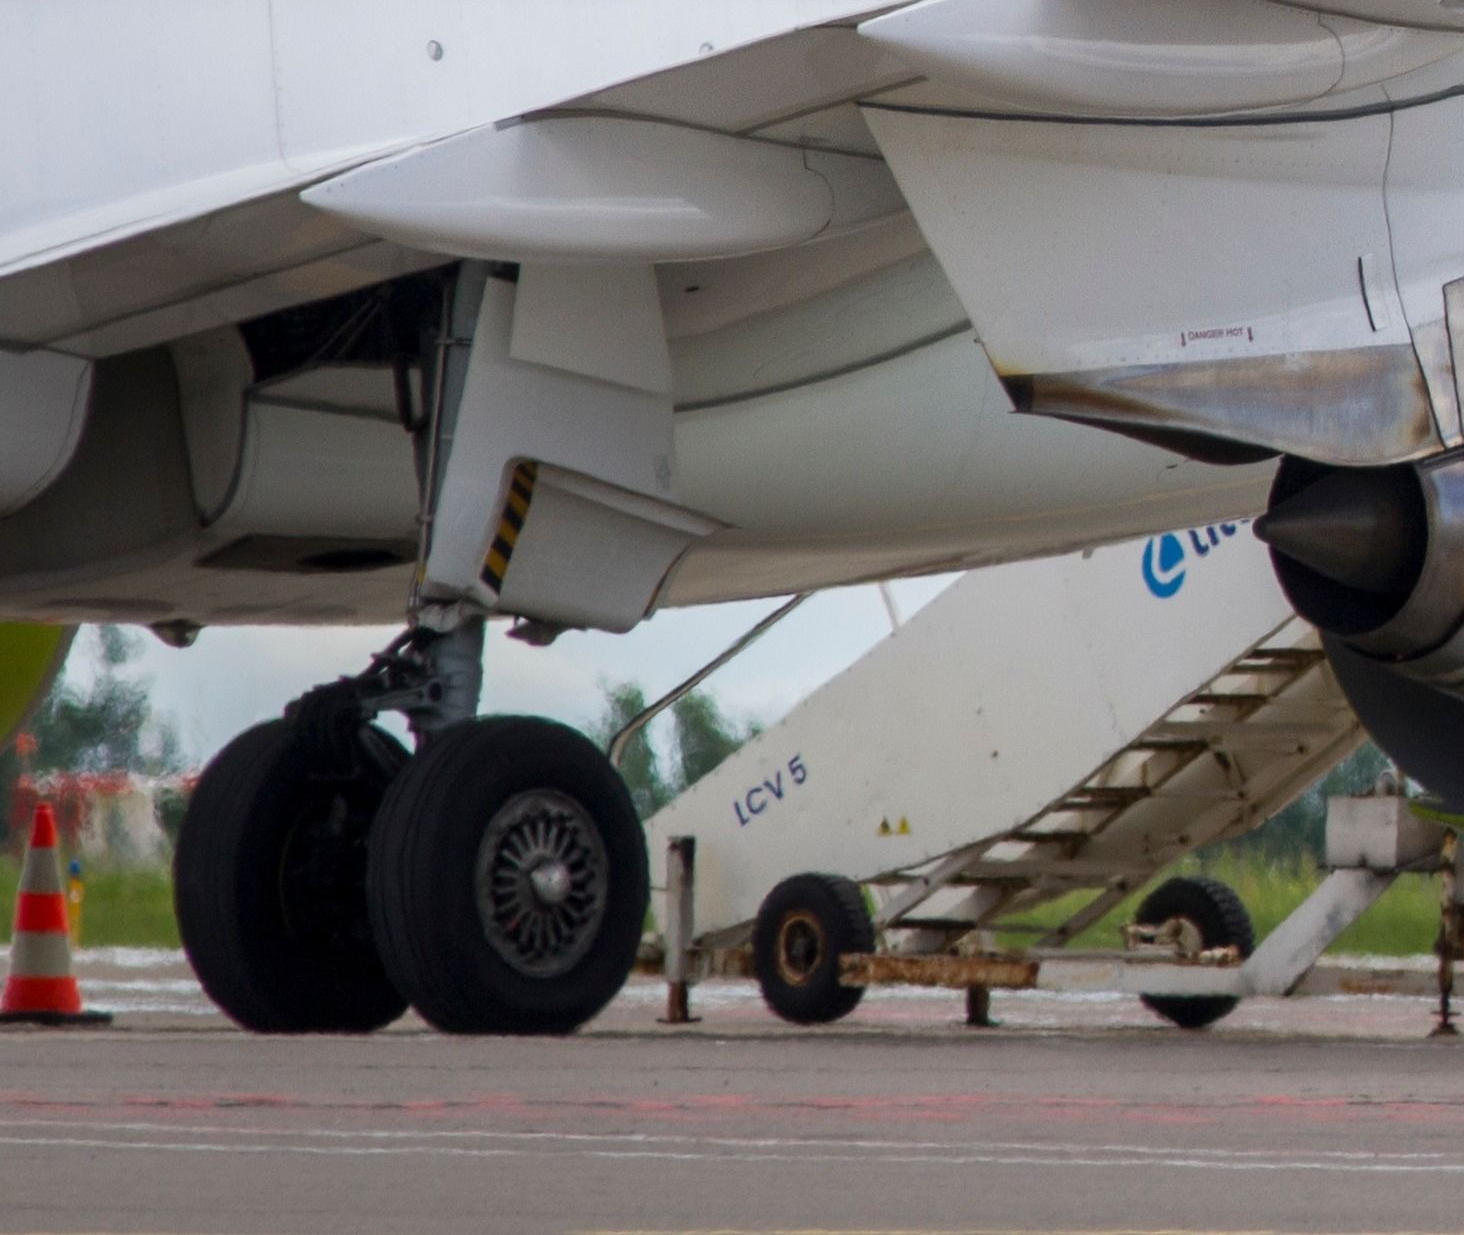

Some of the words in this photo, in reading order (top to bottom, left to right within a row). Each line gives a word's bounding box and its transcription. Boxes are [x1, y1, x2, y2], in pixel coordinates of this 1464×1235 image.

[1226, 327, 1243, 337] HOT
[734, 769, 784, 827] LCV
[787, 754, 807, 785] 5
